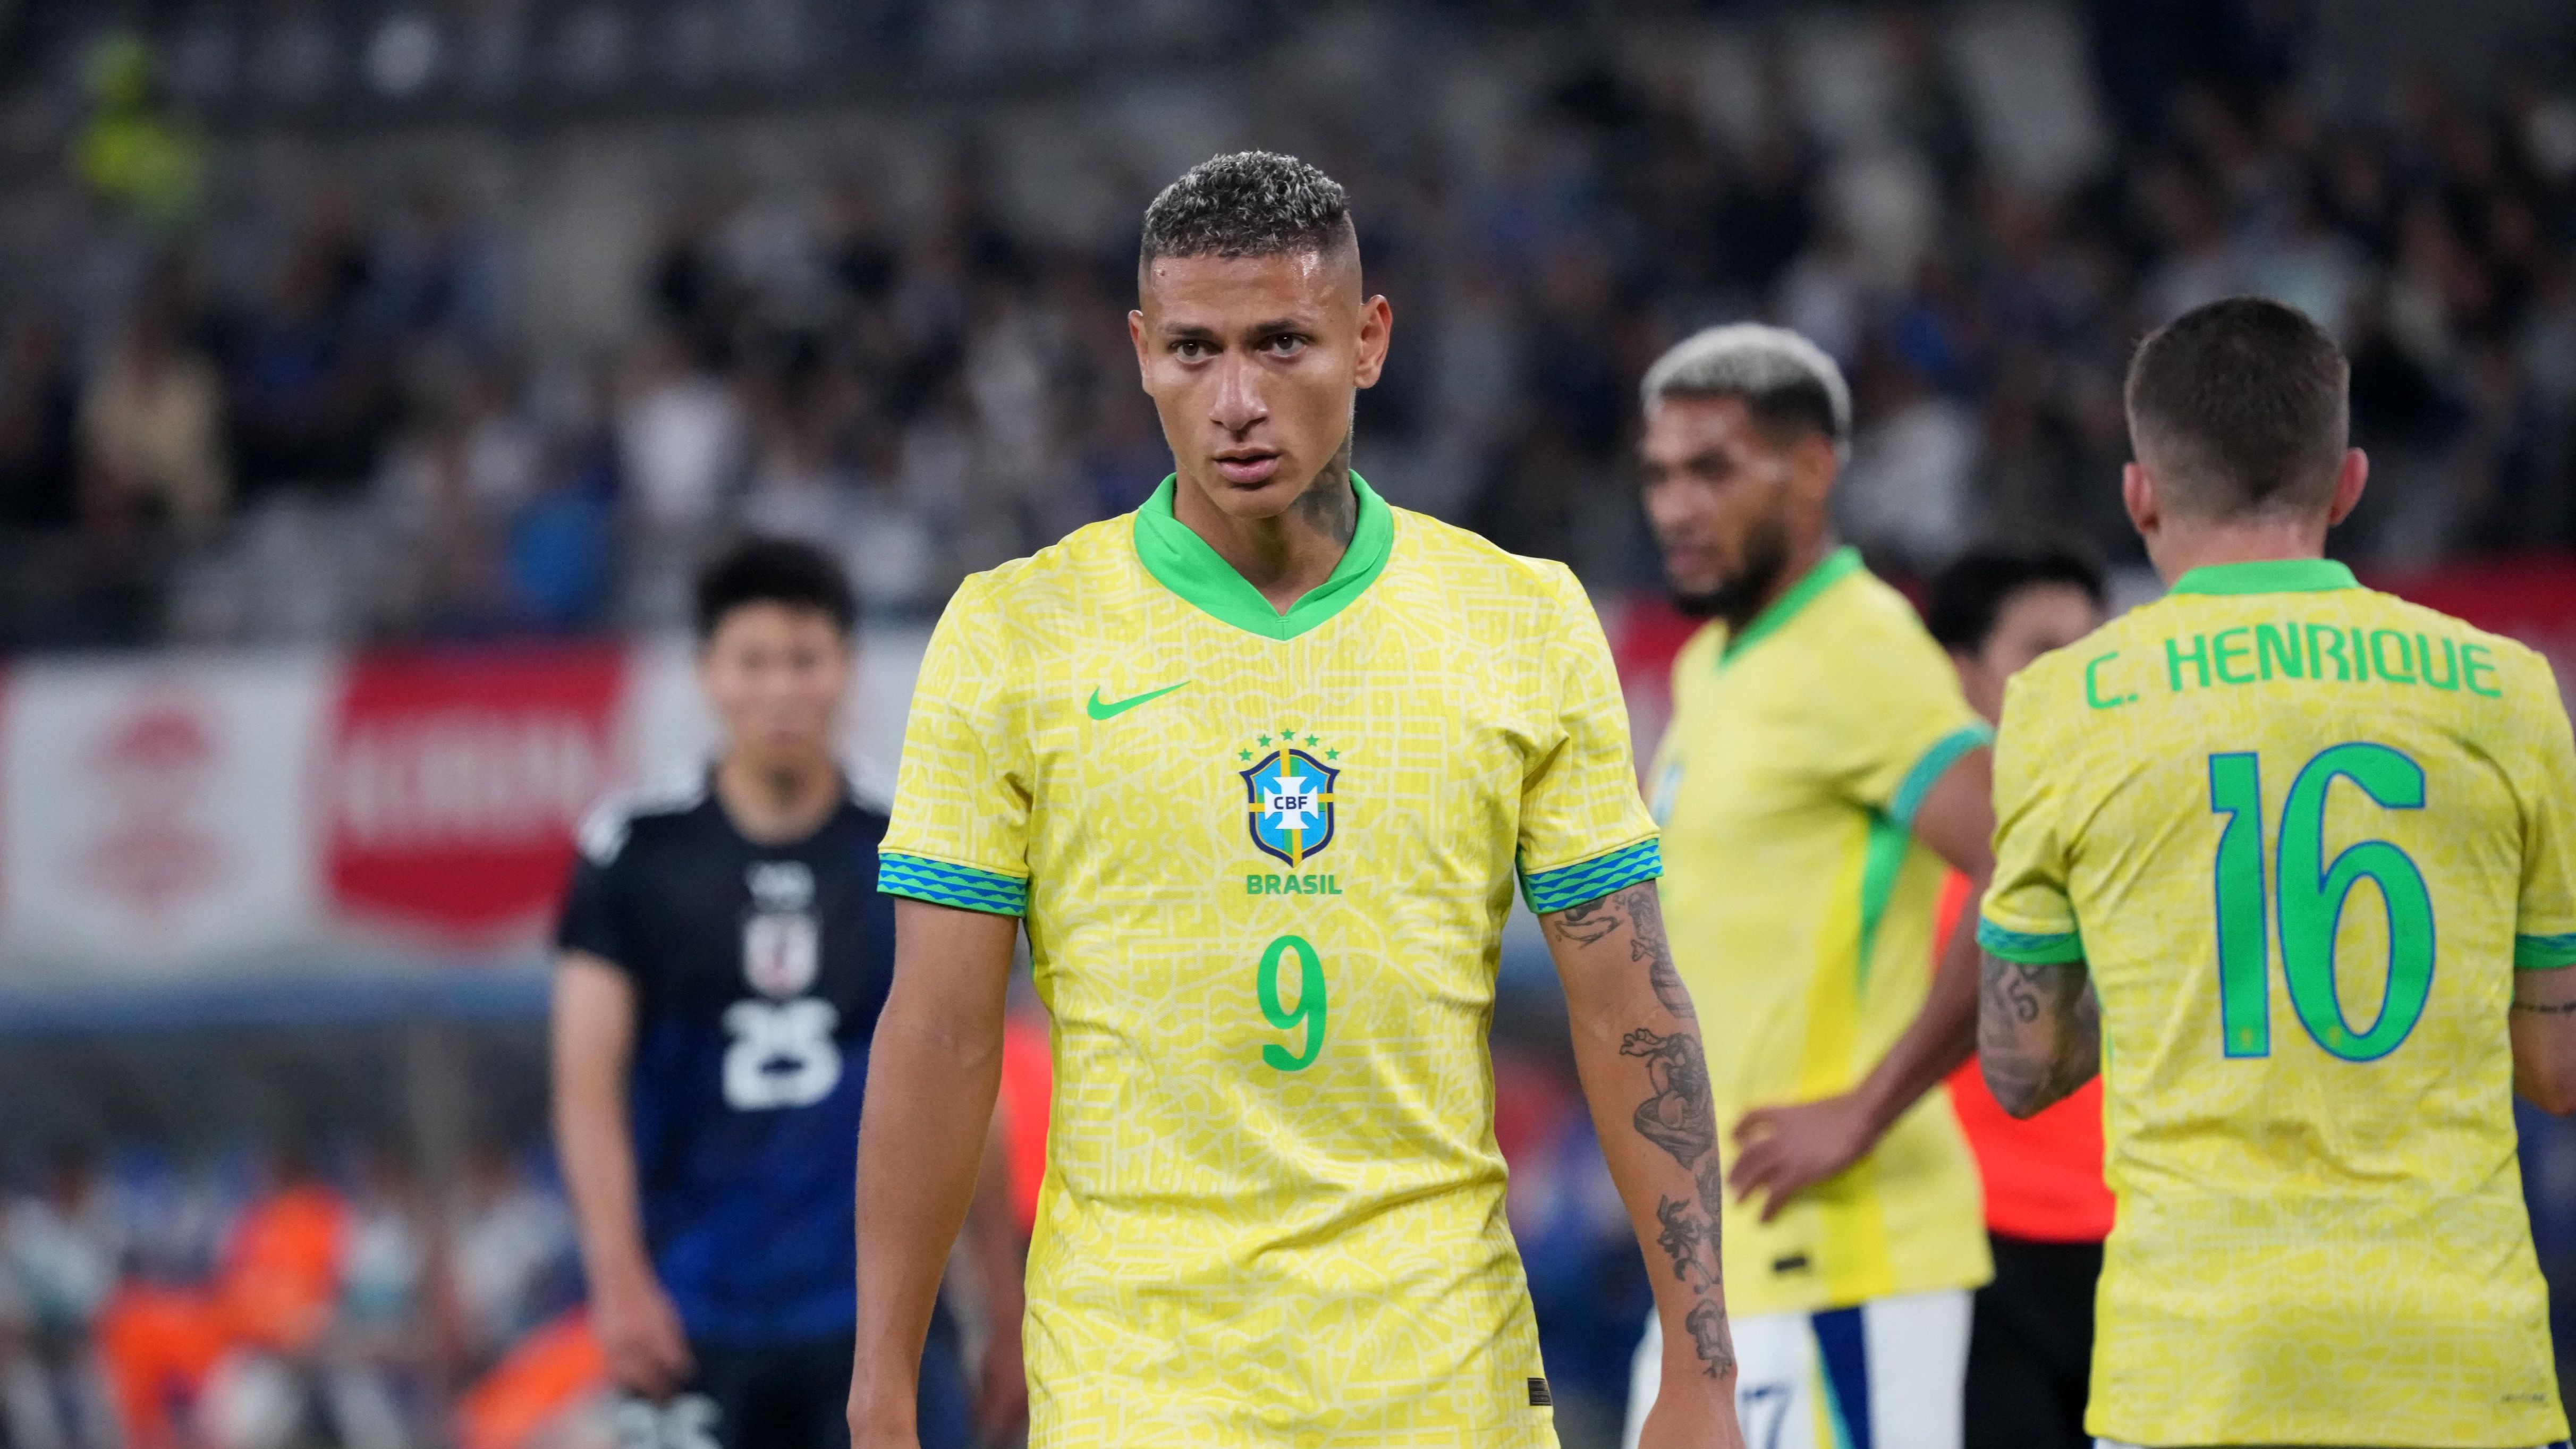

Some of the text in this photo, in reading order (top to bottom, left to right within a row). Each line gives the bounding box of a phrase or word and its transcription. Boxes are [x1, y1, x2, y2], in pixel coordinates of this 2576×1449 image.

[2084, 622, 2502, 709] C. HENRIQUE
[1274, 796, 1308, 810] CBF
[1246, 874, 1343, 895] BRASIL
[2208, 741, 2436, 1062] 16
[1256, 934, 1327, 1072] 9
[722, 997, 843, 1111] 25
